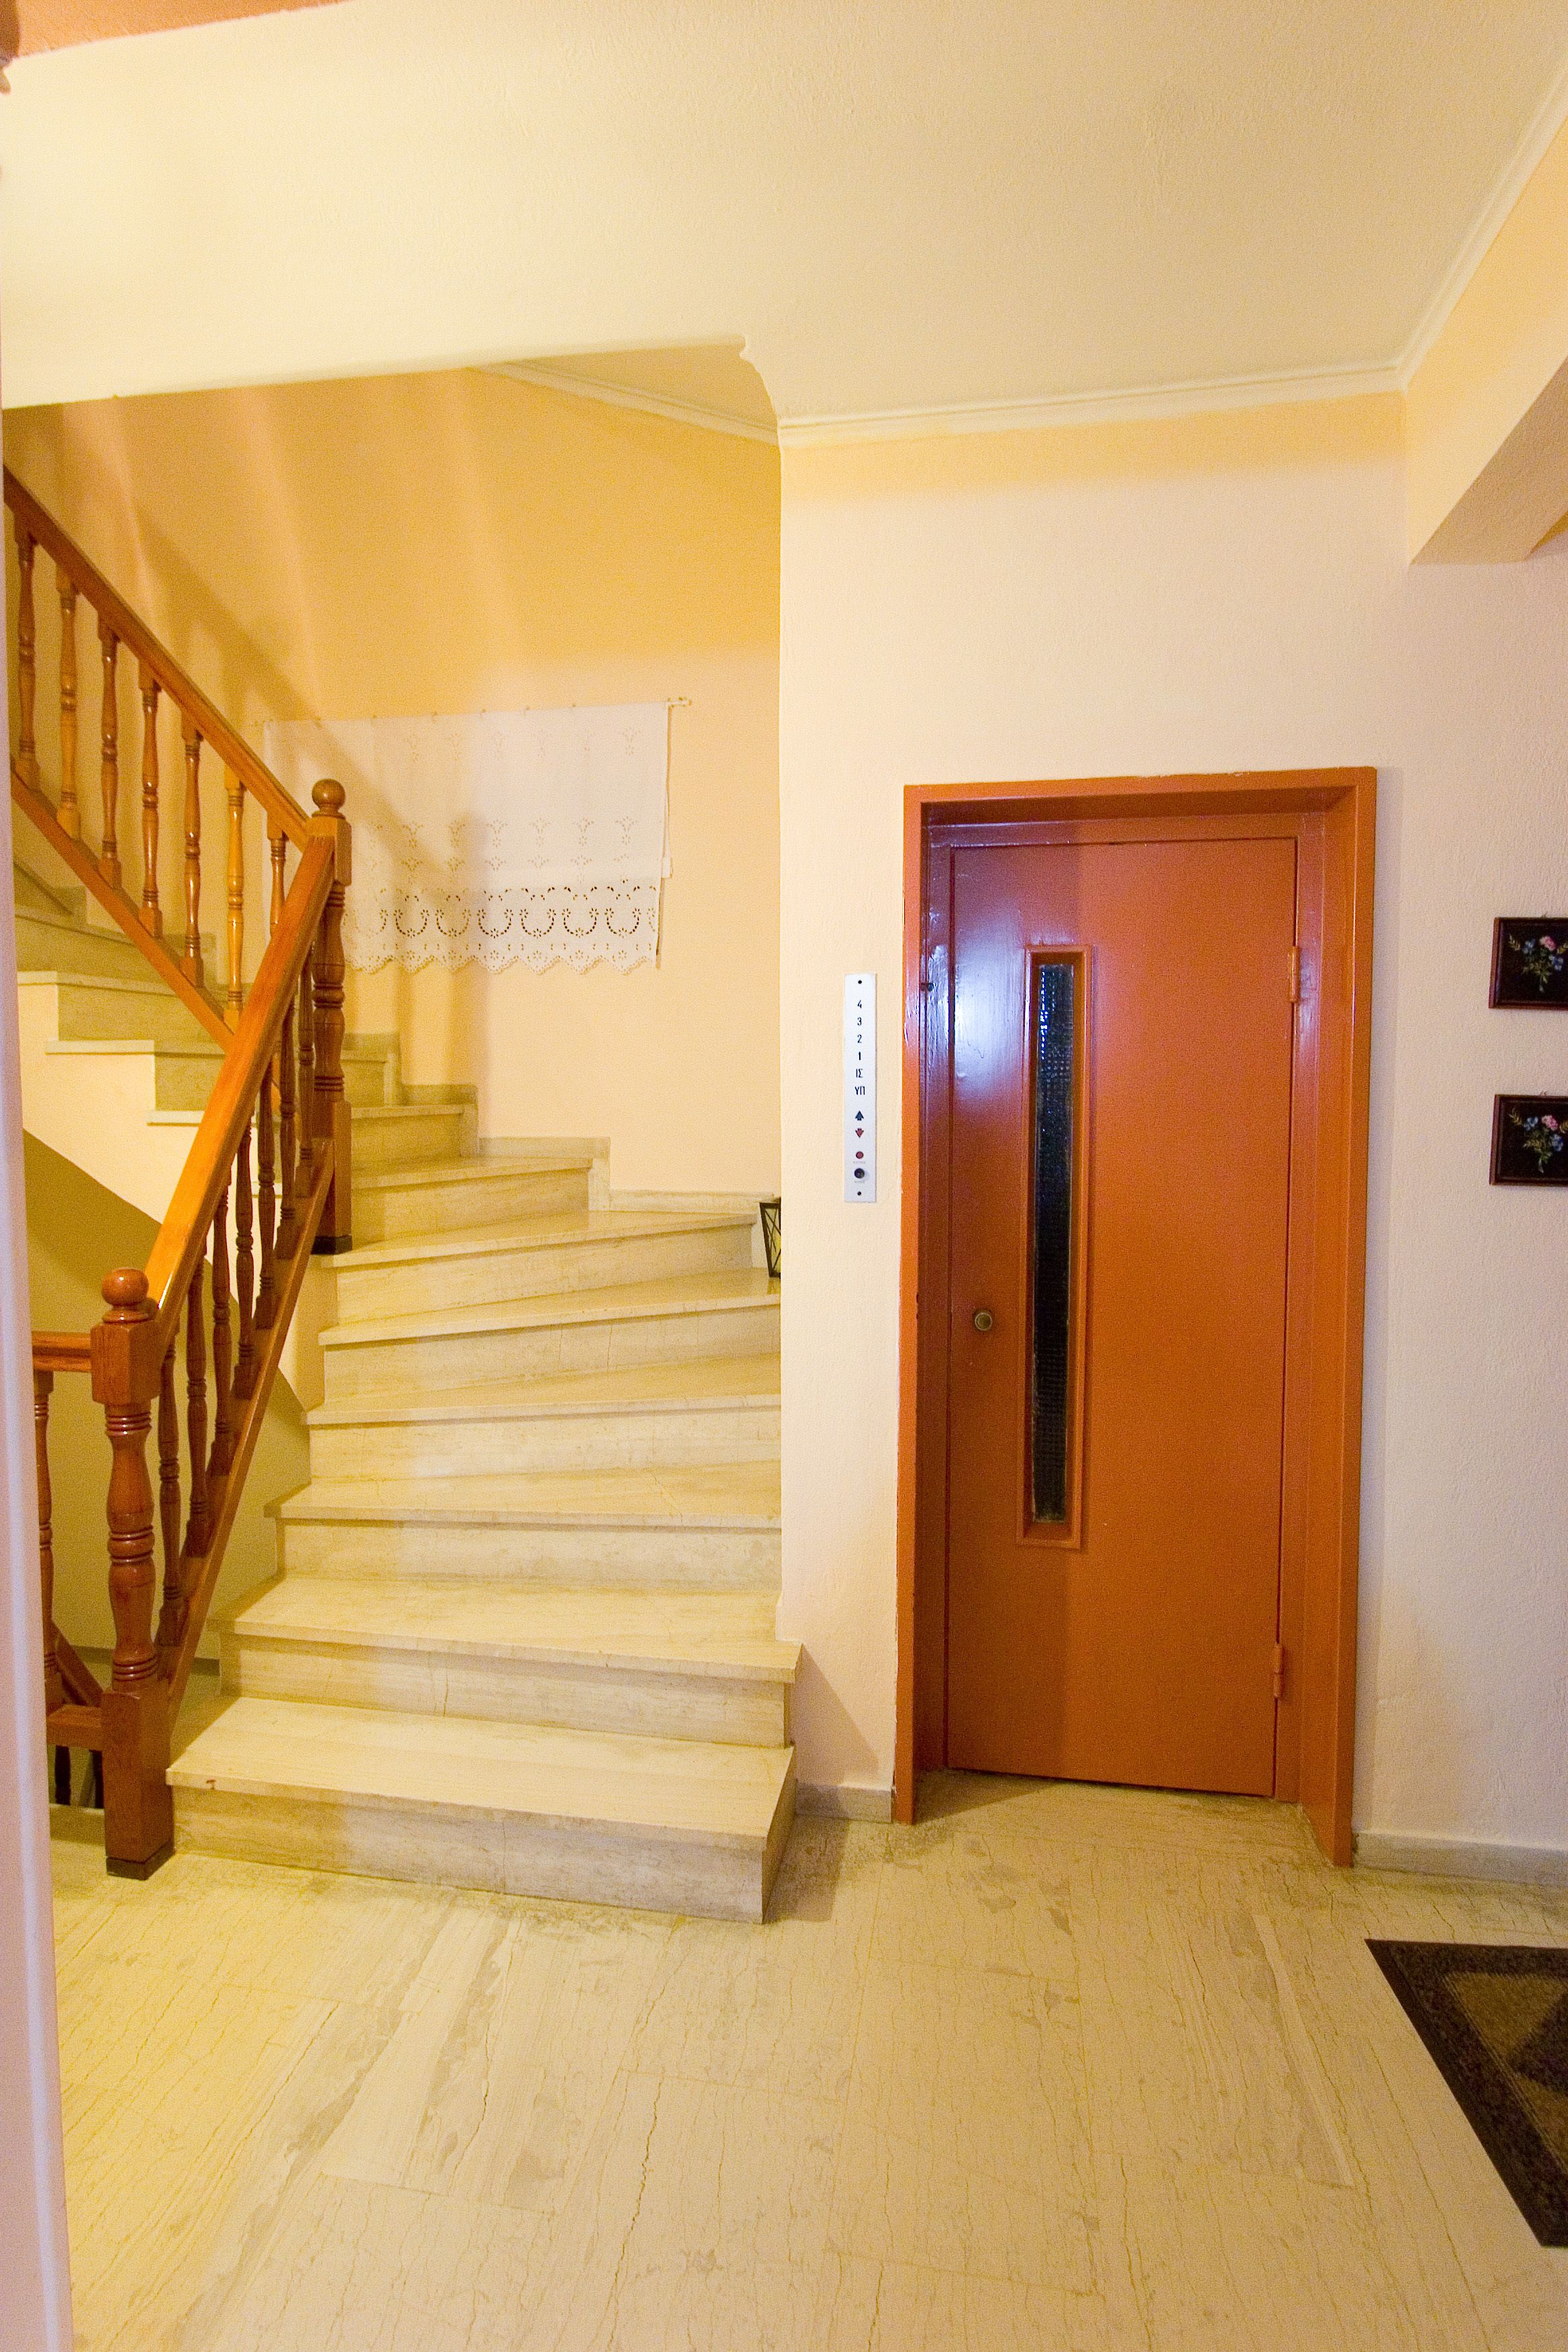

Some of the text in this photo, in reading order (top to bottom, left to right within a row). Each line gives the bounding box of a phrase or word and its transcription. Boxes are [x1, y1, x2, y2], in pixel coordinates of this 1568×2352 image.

[857, 999, 863, 1009] 4
[857, 1017, 862, 1026] 3
[857, 1034, 863, 1044] 2
[858, 1051, 861, 1061] 1
[854, 1085, 865, 1095] ΥΠ
